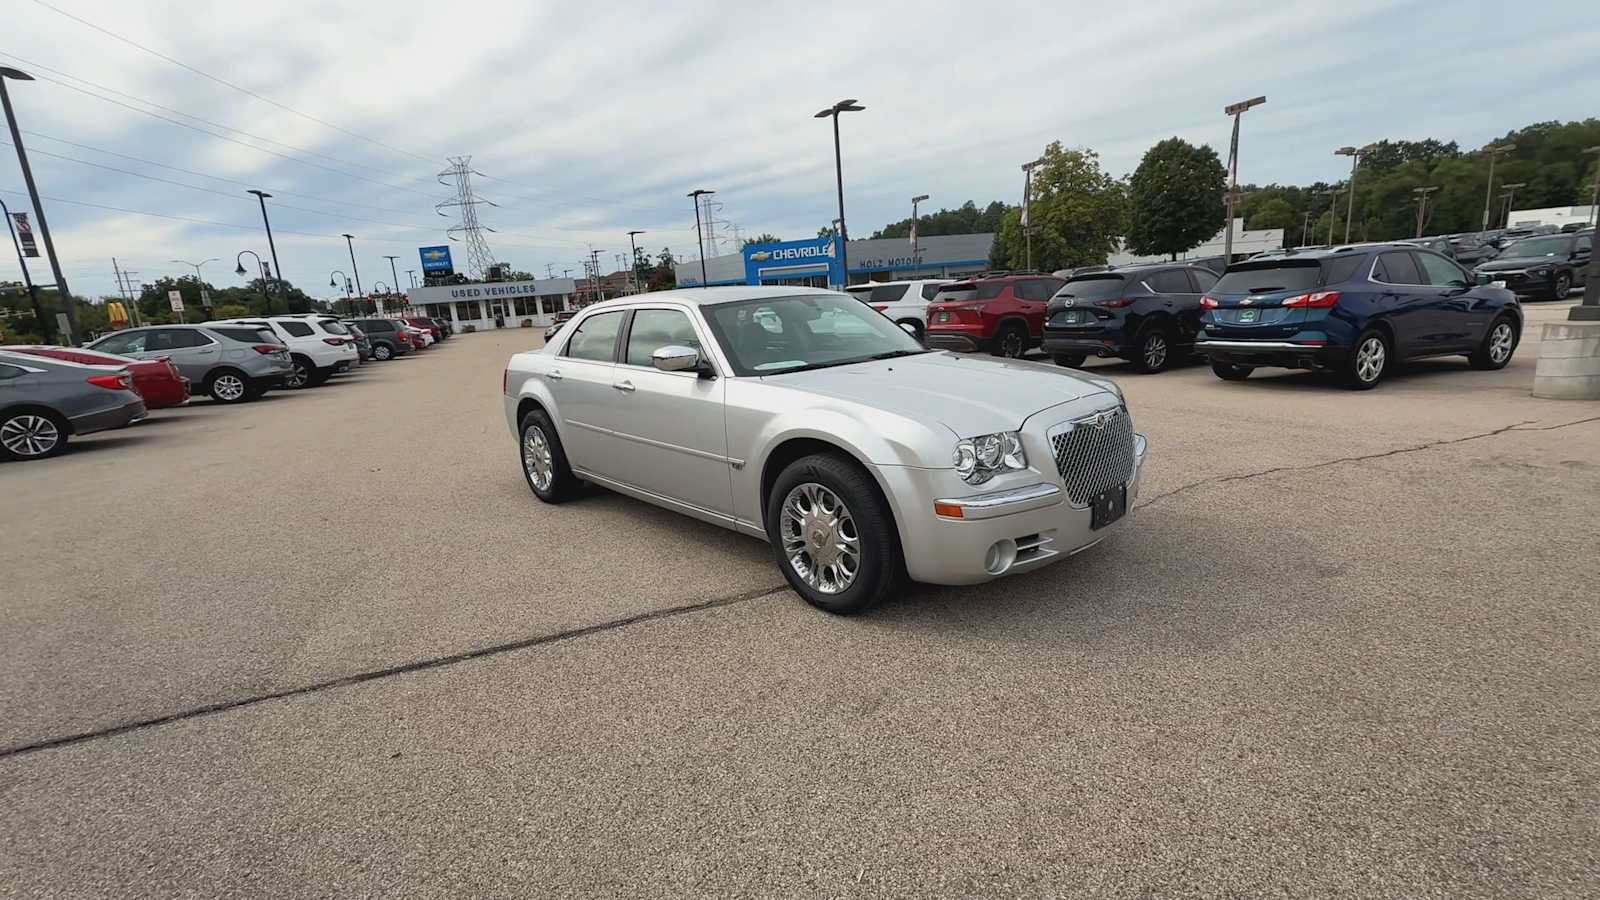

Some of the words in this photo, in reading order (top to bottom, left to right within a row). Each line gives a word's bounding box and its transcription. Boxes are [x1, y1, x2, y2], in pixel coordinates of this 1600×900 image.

[773, 244, 830, 260] CHEVROLE
[860, 259, 883, 268] HOLZ
[451, 288, 480, 298] USED
[484, 284, 536, 296] VEHICLES
